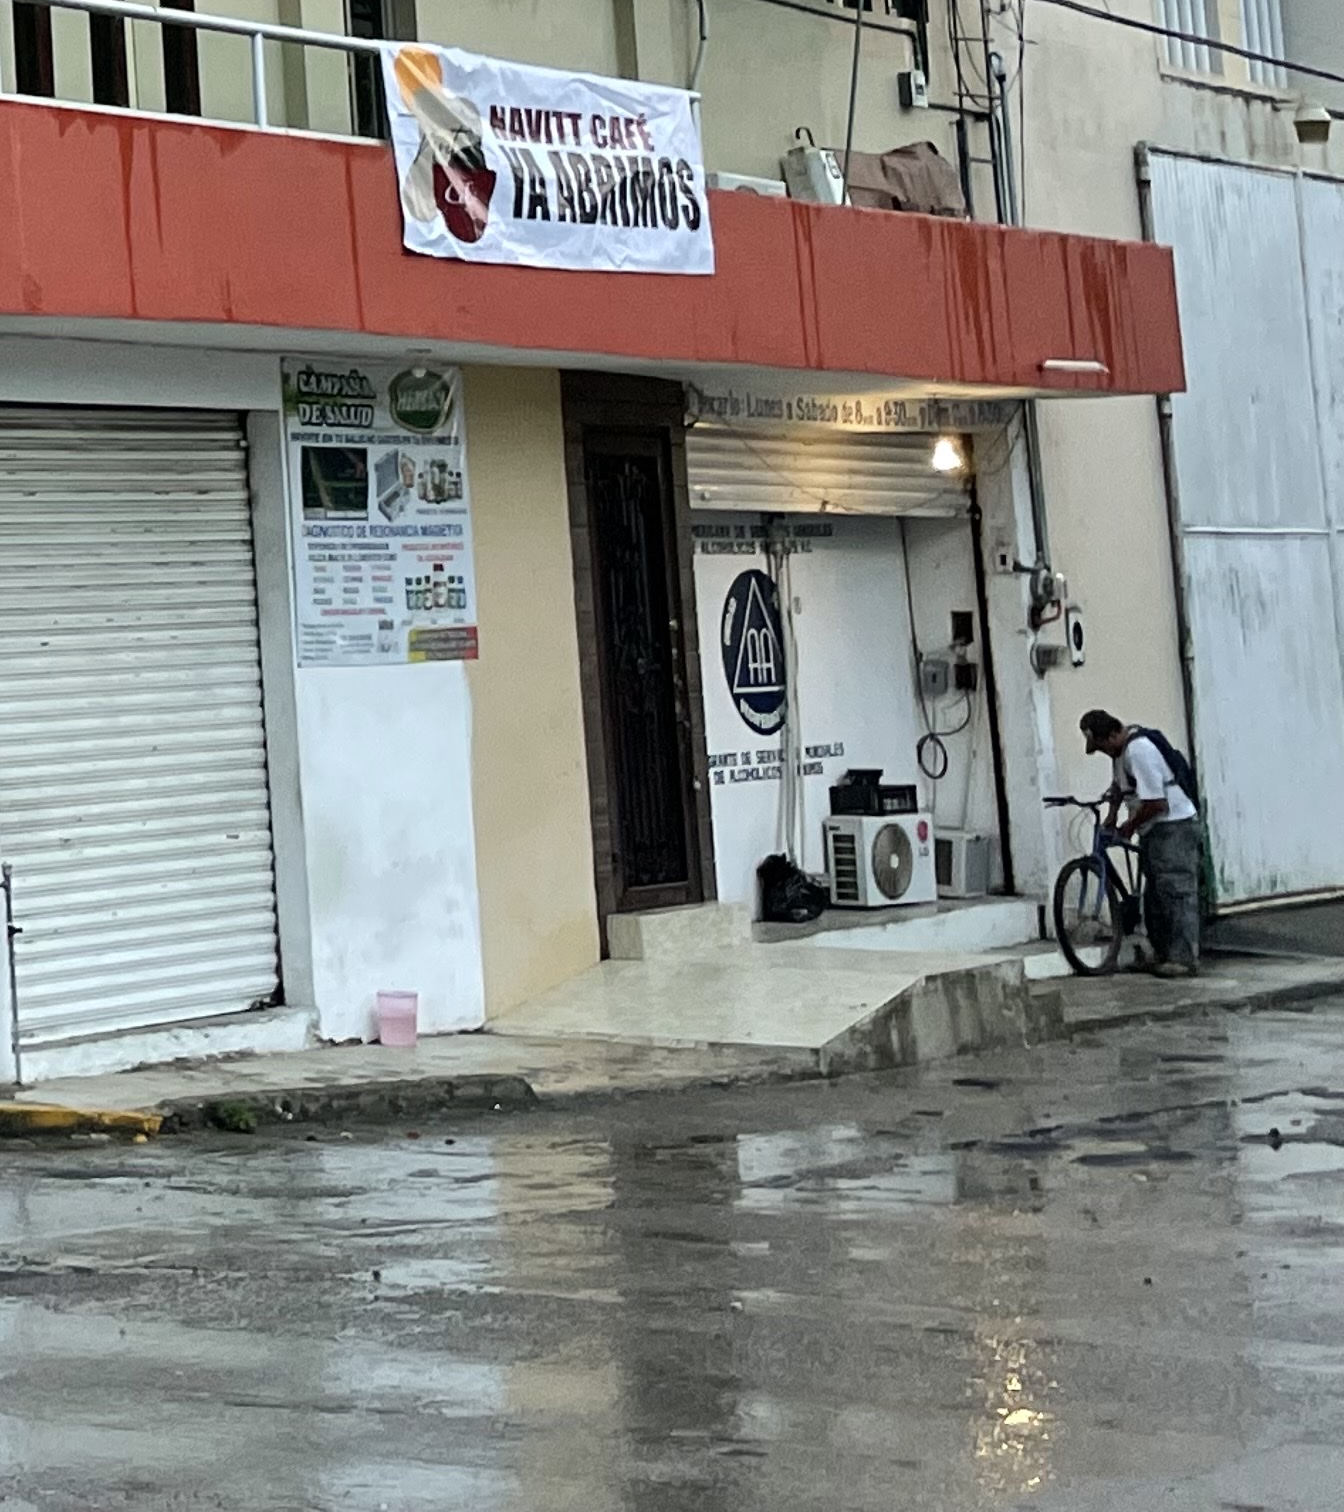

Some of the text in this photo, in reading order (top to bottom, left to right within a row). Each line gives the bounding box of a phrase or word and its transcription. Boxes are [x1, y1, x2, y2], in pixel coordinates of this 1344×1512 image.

[589, 112, 655, 152] CAFÉ
[498, 144, 701, 231] YA ABRIMOS
[298, 403, 374, 428] DE SALUD
